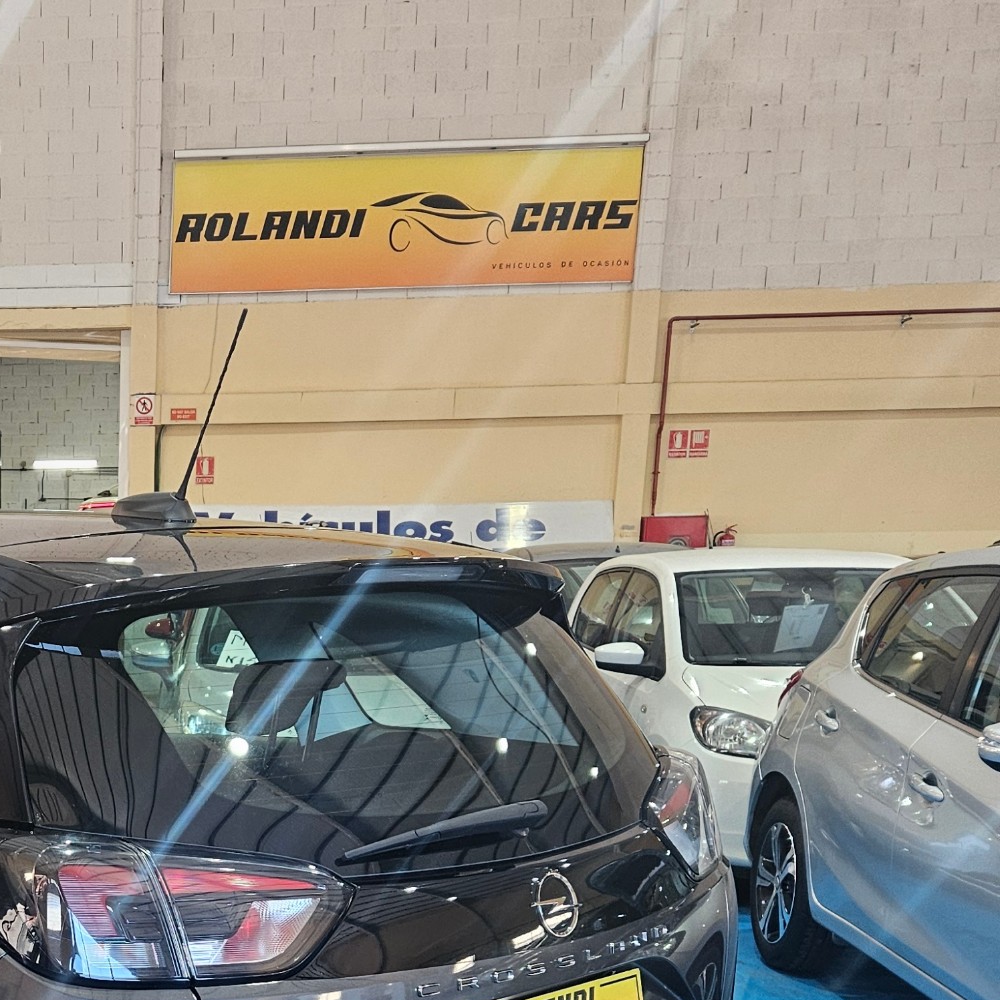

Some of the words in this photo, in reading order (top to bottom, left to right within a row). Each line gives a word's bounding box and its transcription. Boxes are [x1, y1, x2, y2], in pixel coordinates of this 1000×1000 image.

[175, 208, 367, 243] ROLANDI
[511, 200, 638, 232] CARS
[561, 260, 574, 268] DE
[582, 259, 630, 268] OCASIÓN
[475, 508, 546, 542] de
[415, 924, 669, 998] CROSSLAND
